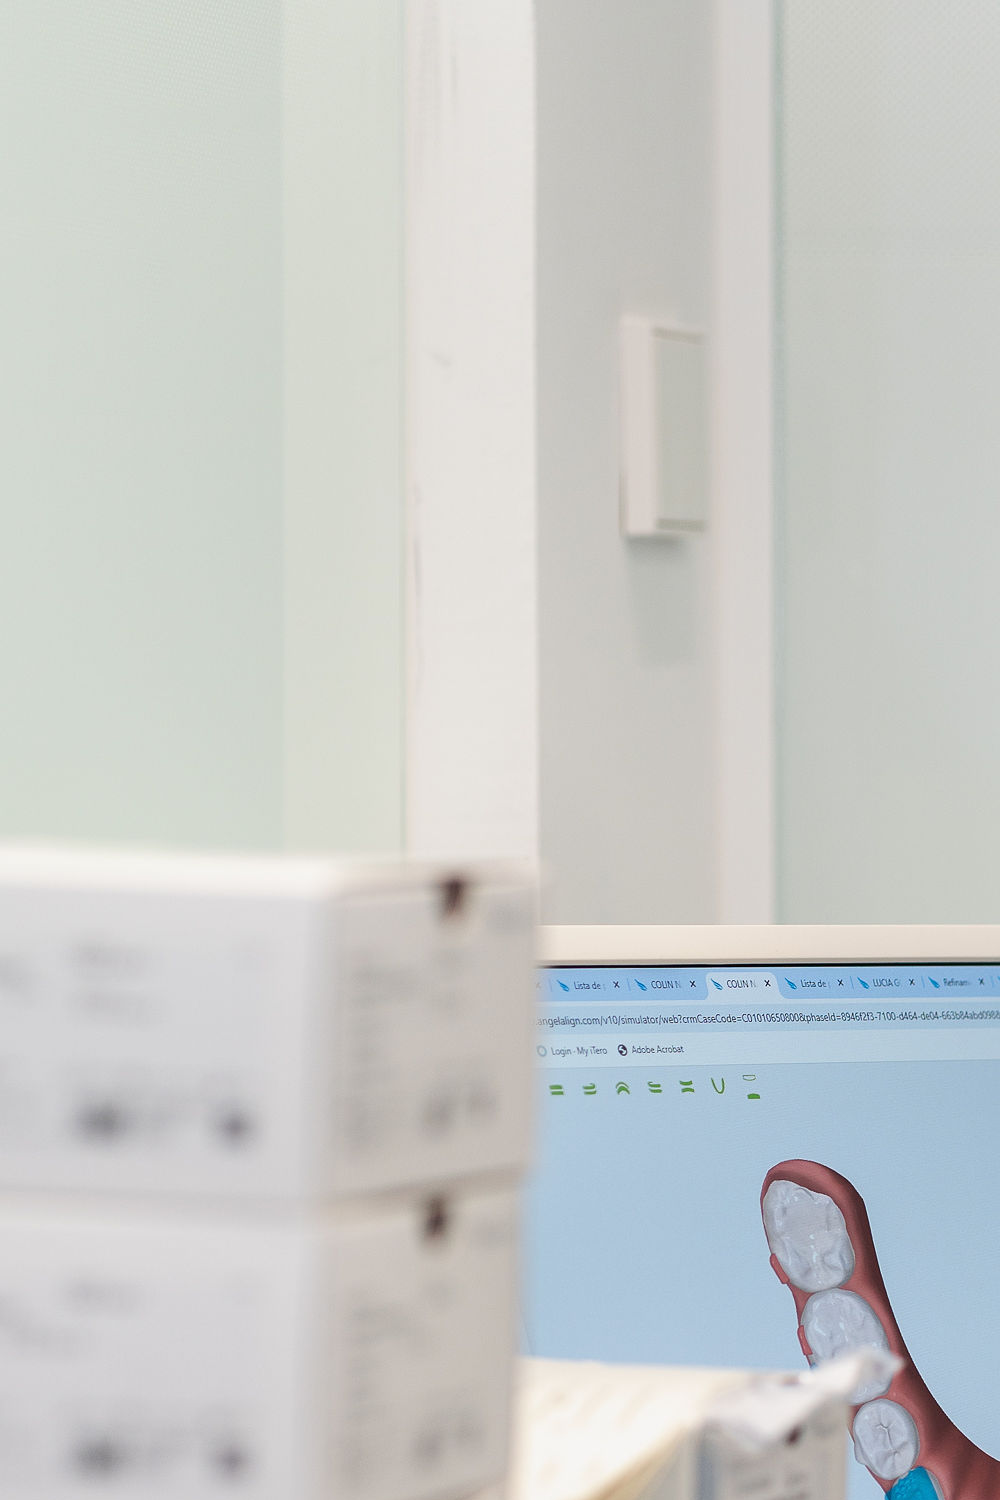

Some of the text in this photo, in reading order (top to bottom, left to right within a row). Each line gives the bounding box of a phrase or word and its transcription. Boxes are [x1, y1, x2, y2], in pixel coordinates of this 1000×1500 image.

[573, 981, 601, 990] Lista de
[651, 980, 674, 989] COLIN
[726, 979, 749, 988] COLIN
[800, 978, 827, 988] Lista de
[872, 978, 893, 987] LUCIA
[551, 1046, 572, 1057] Login
[576, 1046, 588, 1057] My
[590, 1045, 608, 1055] iTero
[632, 1044, 685, 1054] Adobe Acrobat
